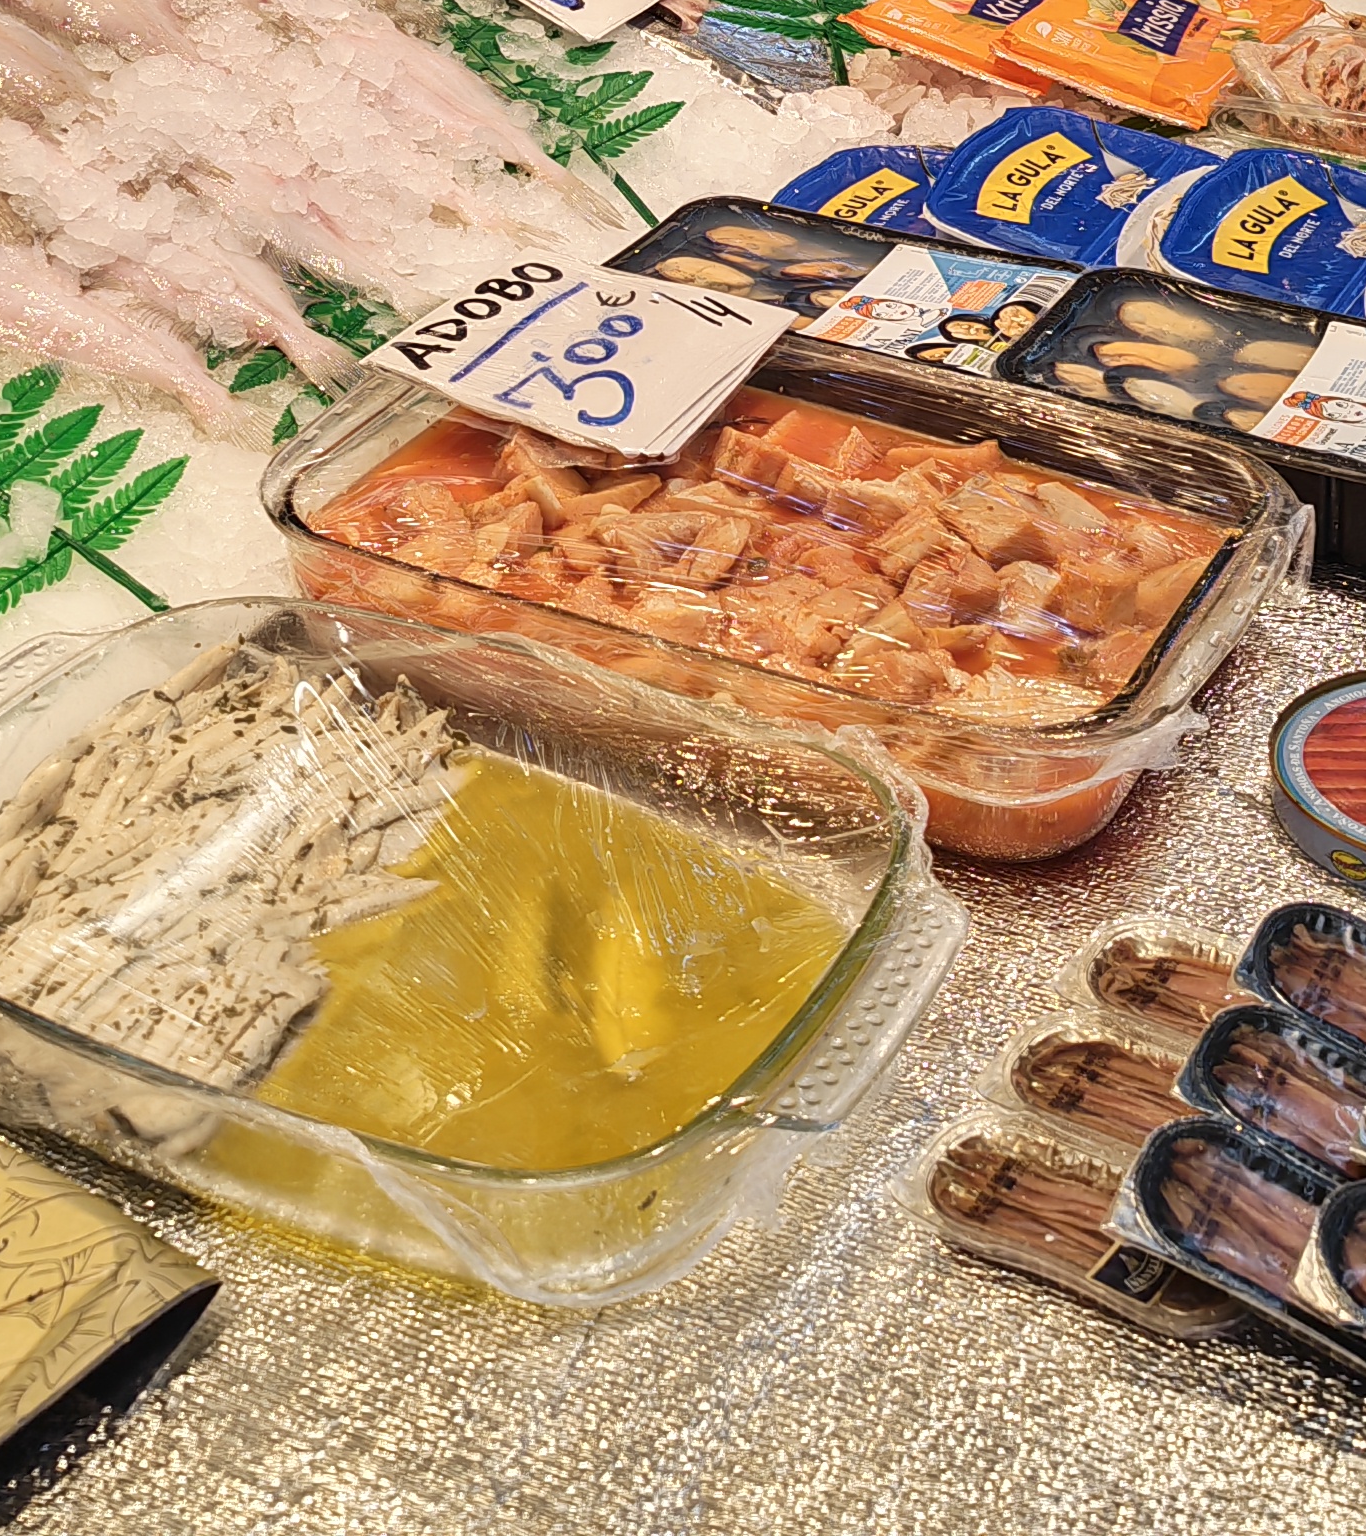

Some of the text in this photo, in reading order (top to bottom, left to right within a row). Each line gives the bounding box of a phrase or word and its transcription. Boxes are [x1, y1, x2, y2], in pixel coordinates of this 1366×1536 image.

[834, 180, 886, 220] GULA
[992, 150, 1060, 213] LA GULA
[1058, 169, 1085, 199] NORTE
[1226, 197, 1301, 262] LA GULA
[1277, 219, 1322, 260] DEL NORTE
[390, 261, 564, 371] ADOBO
[1287, 712, 1320, 753] SANTOÑA
